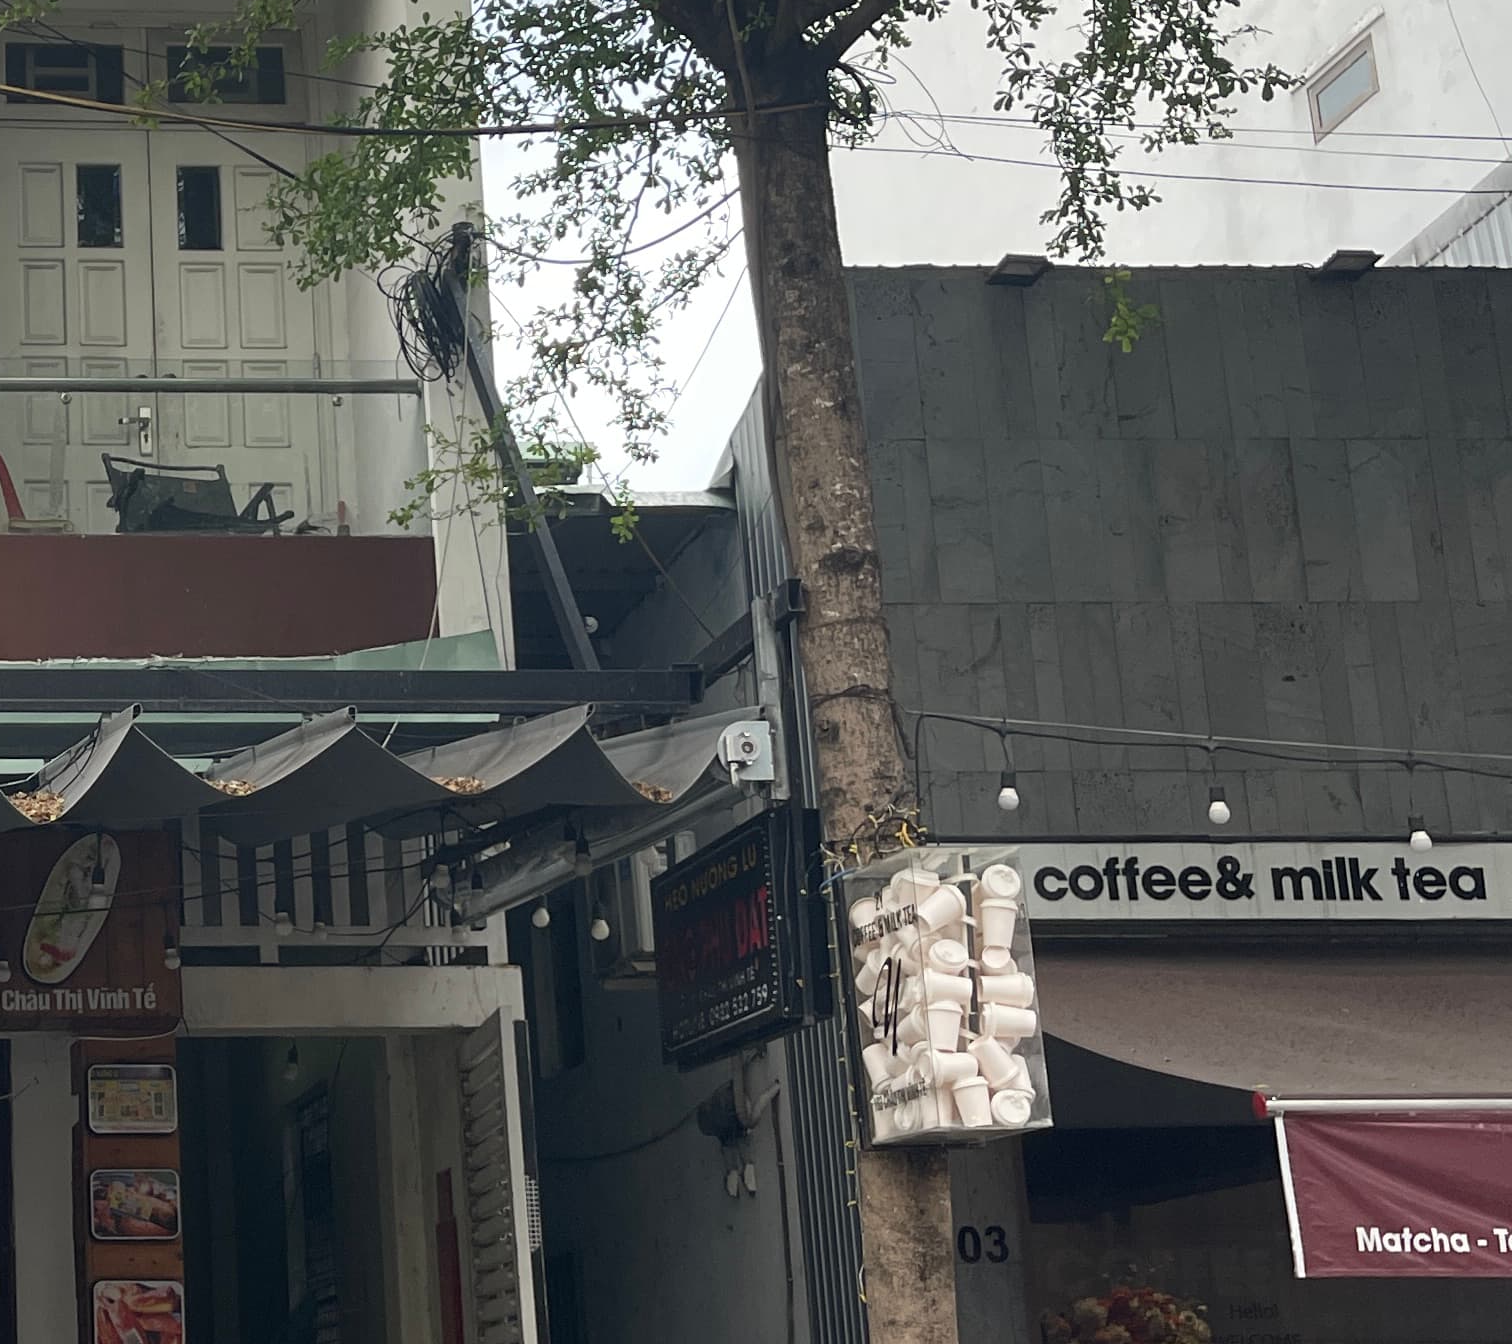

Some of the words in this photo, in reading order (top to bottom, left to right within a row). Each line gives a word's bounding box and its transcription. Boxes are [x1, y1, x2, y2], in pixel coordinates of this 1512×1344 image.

[1271, 856, 1383, 902] milk
[1390, 862, 1487, 902] tea
[53, 987, 83, 1014] Thị
[132, 982, 158, 1010] Tế
[1356, 1226, 1471, 1254] Matcha
